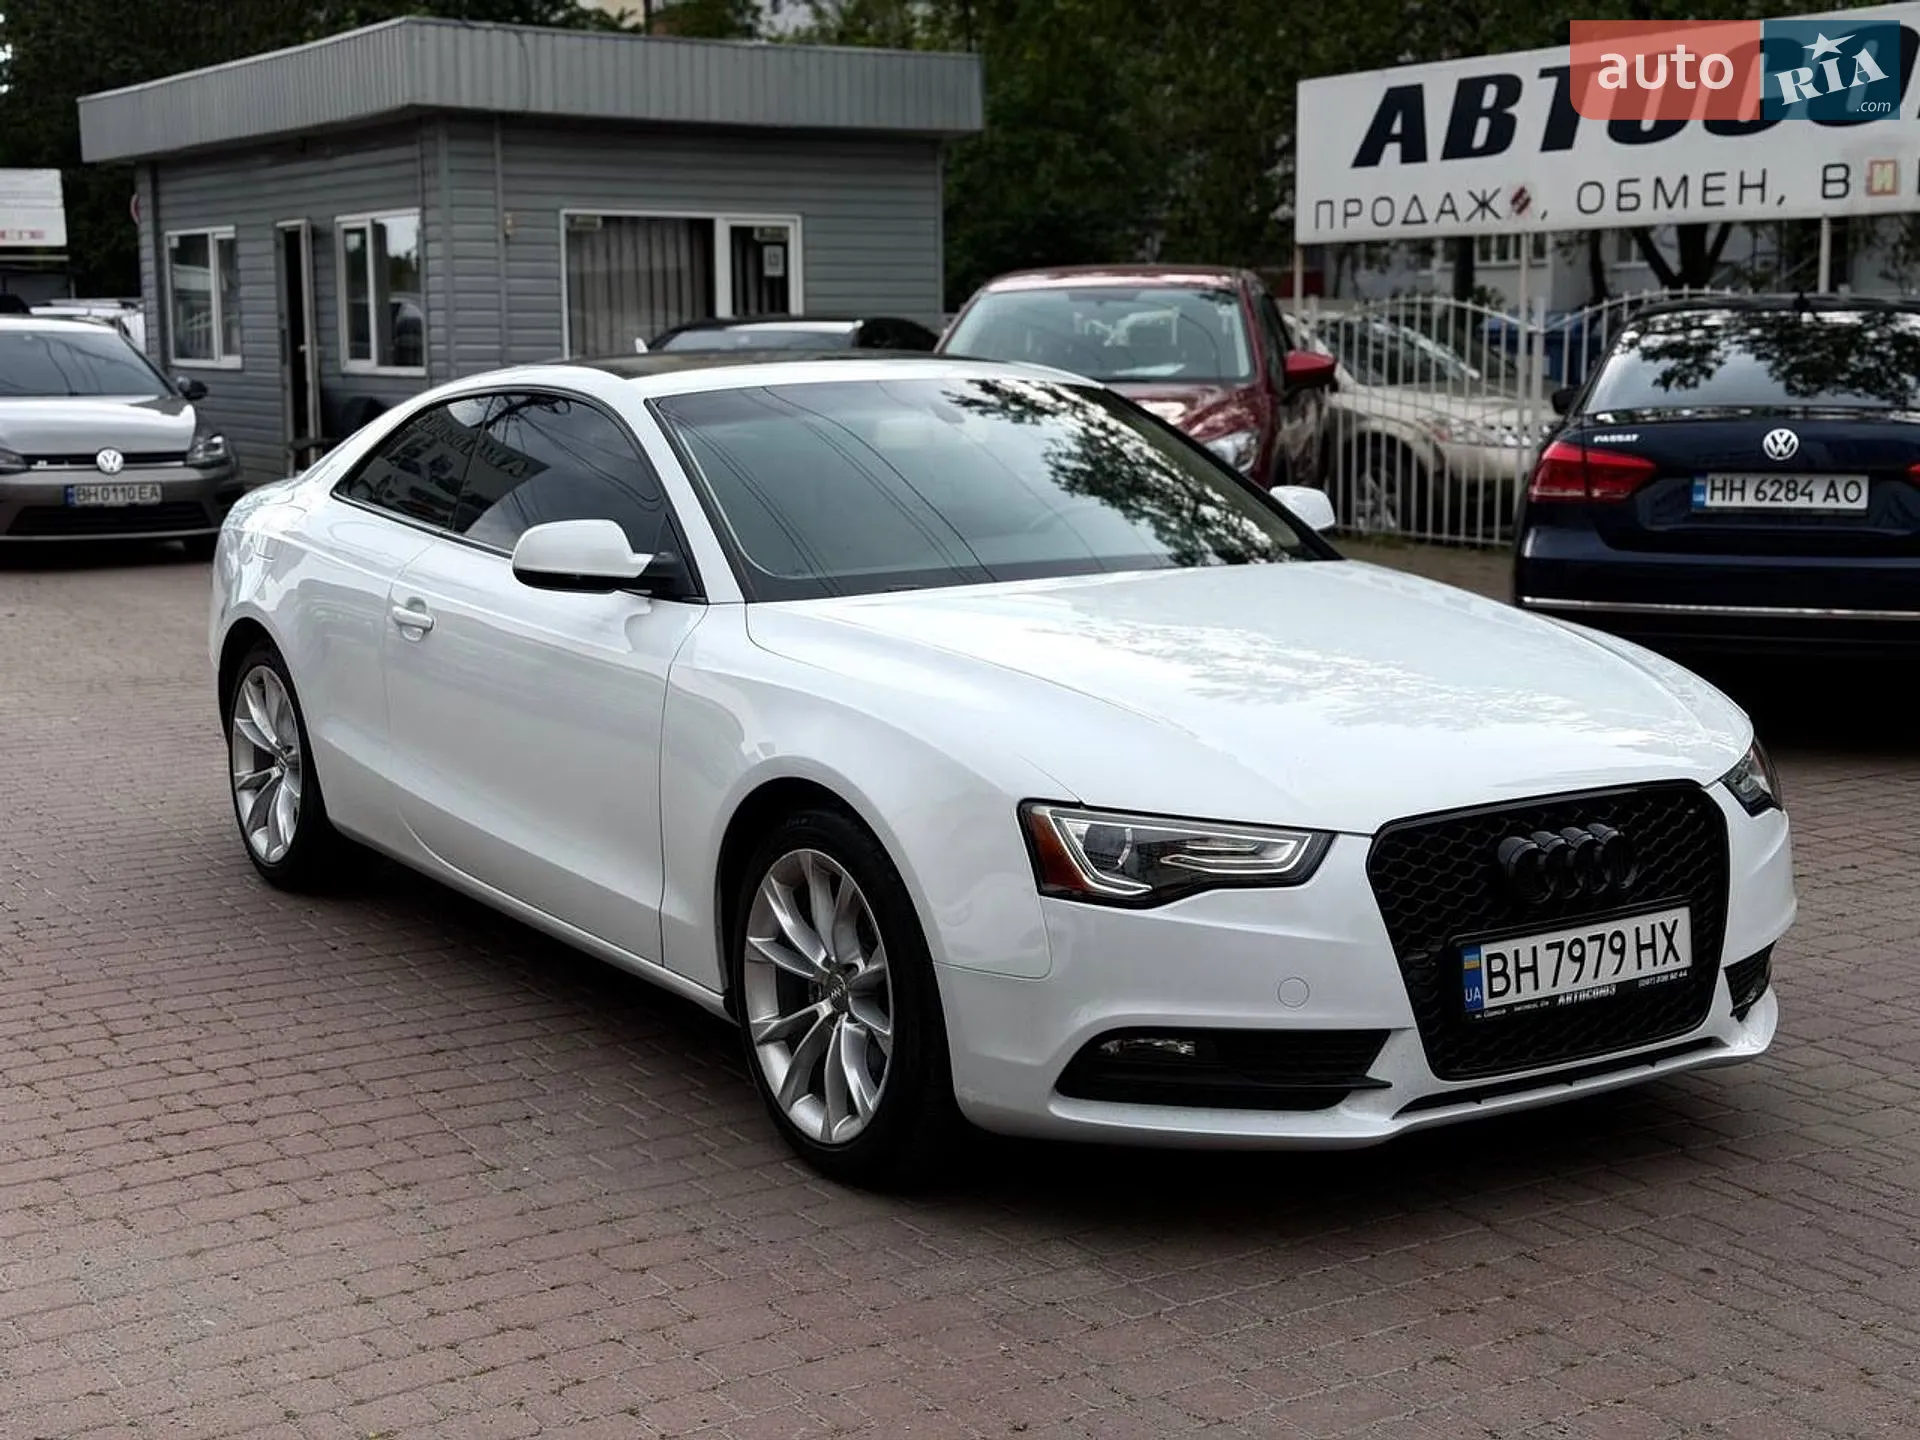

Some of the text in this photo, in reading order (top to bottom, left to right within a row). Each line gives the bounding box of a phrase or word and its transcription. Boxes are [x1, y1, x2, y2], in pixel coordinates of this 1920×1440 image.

[1350, 23, 1920, 168] АВТОСО
[1576, 168, 1787, 215] ОБМЕН,
[101, 486, 136, 502] 0110
[1709, 478, 1862, 504] HH 6284 AO
[1485, 918, 1681, 999] BH 7979 HX
[1464, 985, 1482, 1003] UA
